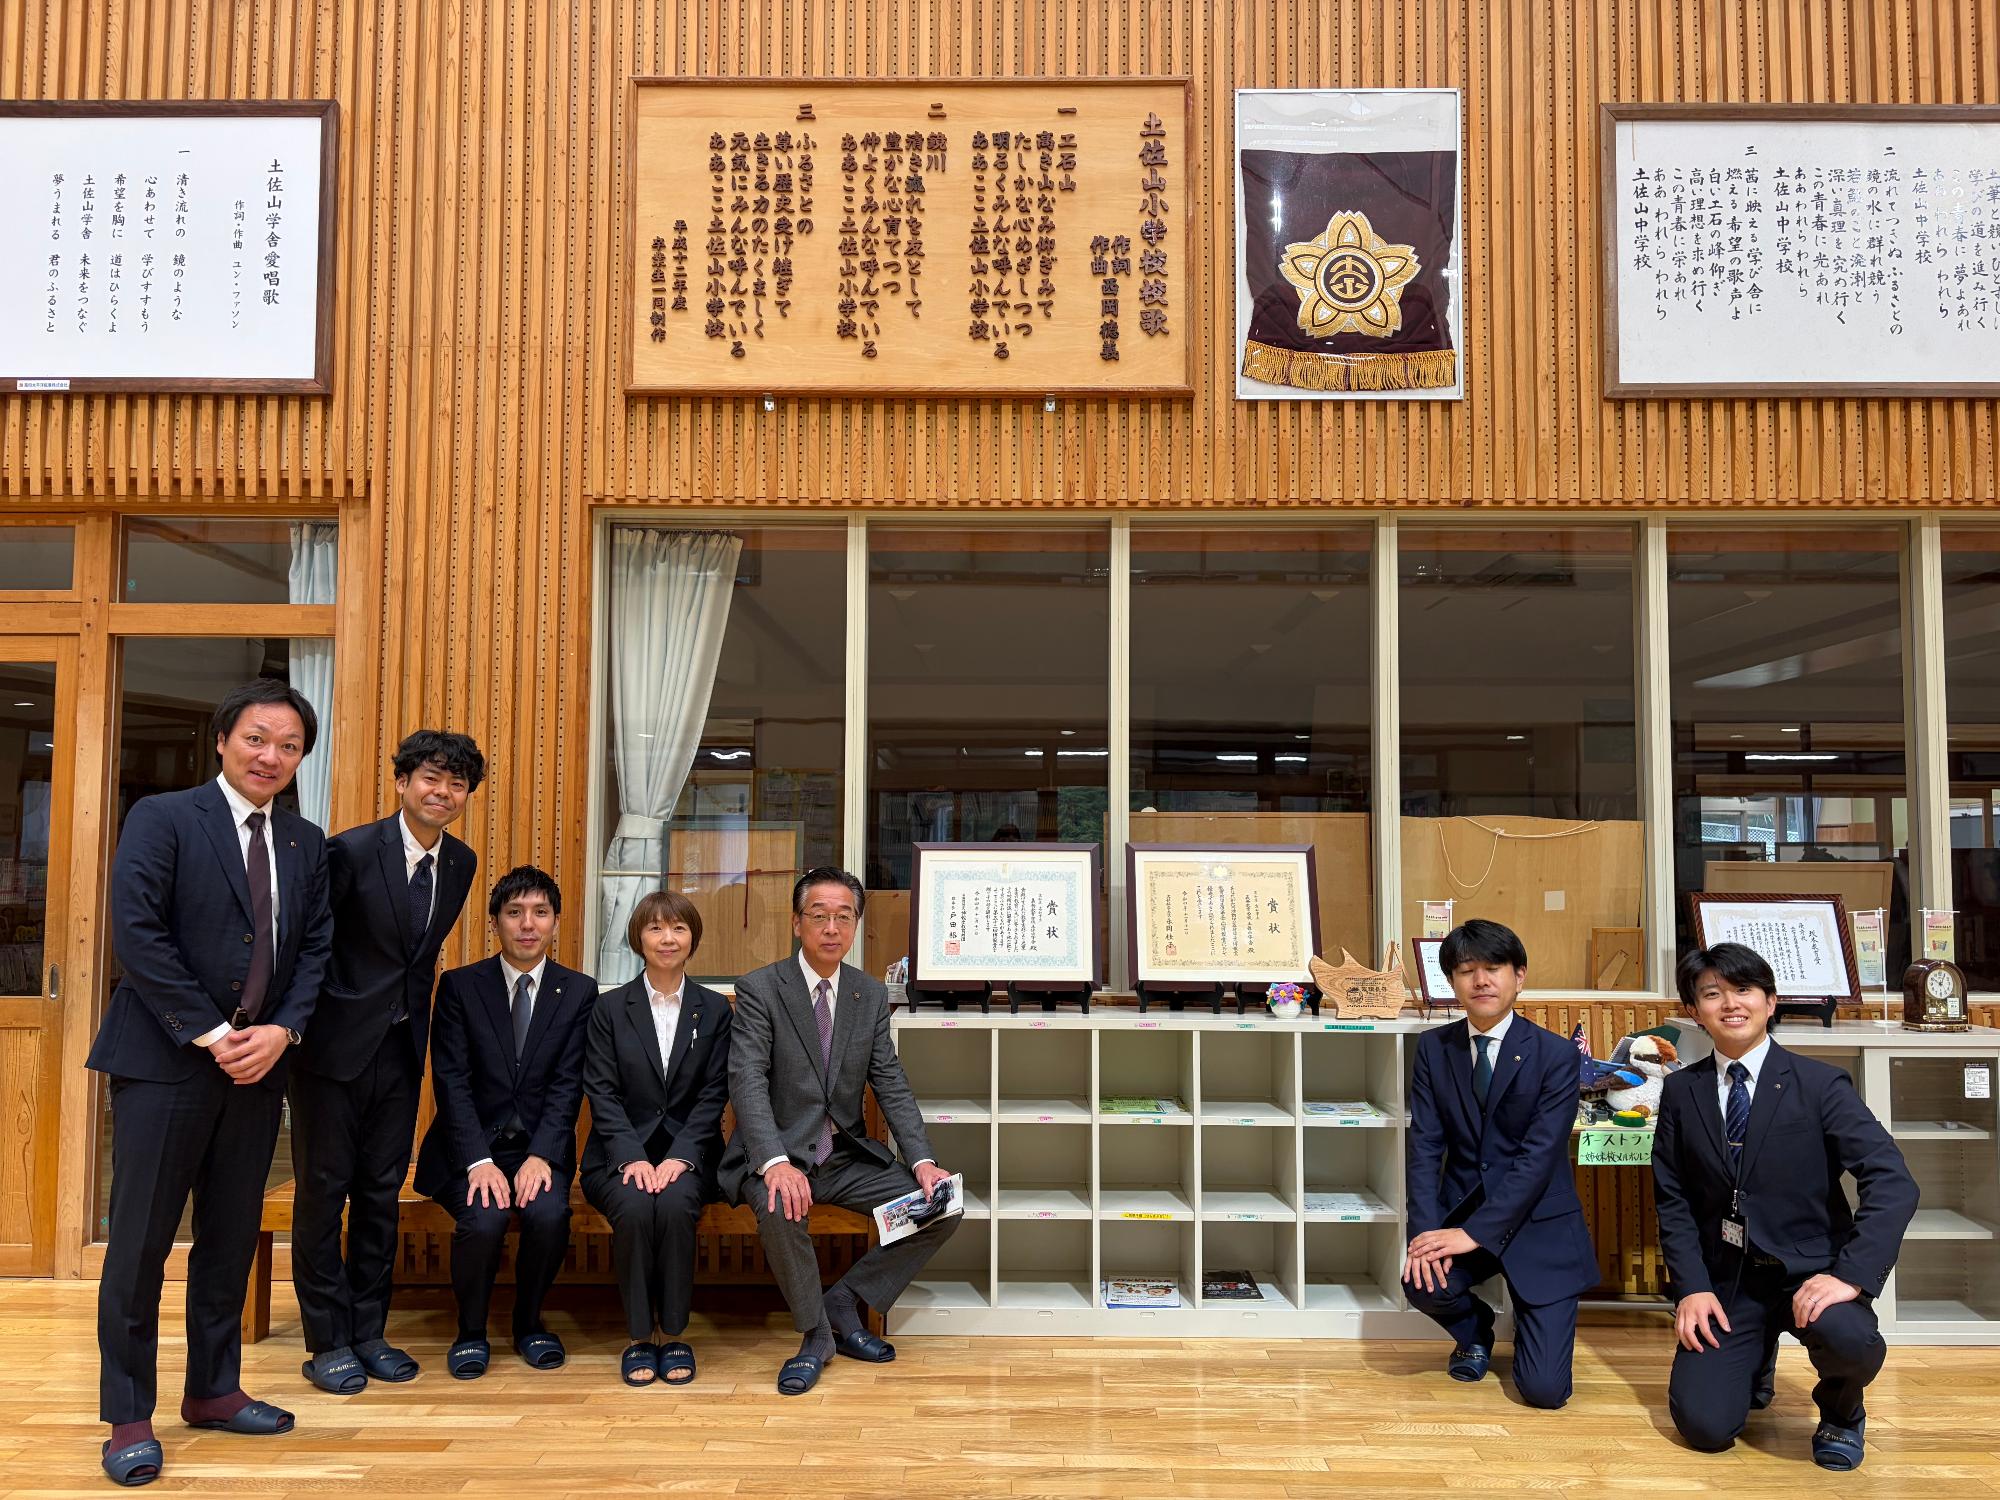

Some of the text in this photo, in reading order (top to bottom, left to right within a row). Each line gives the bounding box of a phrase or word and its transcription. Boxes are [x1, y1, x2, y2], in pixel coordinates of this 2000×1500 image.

[176, 173, 189, 237] 清き流れの
[796, 104, 816, 235] 三 ふるさとの
[926, 103, 947, 173] 二 鏡川
[1056, 134, 1077, 192] 工石山
[47, 174, 64, 332] 夢うまれる 君のふるさと
[78, 175, 95, 332] 土佐山学舎 未来をつなぐ
[109, 174, 126, 332] 希望を胸に 道はひらくよ
[140, 177, 157, 331] 心あわせて 学びすすもう
[172, 254, 185, 320] 鏡のような
[263, 159, 283, 305] 土佐山学舎愛唱歌
[672, 220, 687, 312] 平成十二年度
[705, 132, 726, 339] ああここ土佐山小学校
[728, 132, 751, 359] 元気にみんな呼んでいる
[752, 132, 771, 339] 生きる力のたくましく
[772, 131, 793, 318] 尊い歴史受け継ぎて
[837, 133, 858, 340] ああここ土佐山小学校
[860, 132, 880, 359] 仲よくみんな呼んでいる
[883, 132, 903, 295] 豊かな心育てつつ
[904, 131, 925, 319] 清き流れを友として
[970, 131, 990, 341] ああここ土佐山小学校
[992, 131, 1012, 360] 明るくみんな呼んでいる
[1013, 132, 1034, 336] たしかな心めざしつつ
[1036, 131, 1056, 319] 高き山なみ仰ぎみて
[1090, 235, 1109, 276] 作曲
[1111, 235, 1131, 276] 作詞
[1139, 112, 1169, 337] 土佐山小学校校歌
[1632, 168, 1652, 270] 土佐山中学校
[1670, 168, 1688, 301] この青春に栄あれ
[1689, 168, 1707, 312] 高い理想を求め行く
[1707, 168, 1726, 296] 白い工石の峰仰ぎ
[1724, 168, 1744, 320] 燃える希望の歌声よ
[1744, 145, 1763, 314] 三 茜に映える学び舎に
[1772, 167, 1794, 273] 土佐山中学校
[1810, 168, 1830, 305] この青春に光あれ
[1827, 168, 1849, 325] 深い真理を究め行く
[1864, 168, 1886, 304] 鏡の水に群れ競う
[1912, 168, 1933, 264] 土佐山中学校
[1969, 169, 1989, 328] 学びの道を進み行く
[650, 236, 666, 343] 卒業生一同制作
[1046, 900, 1059, 939] 賞状
[1267, 897, 1280, 934] 賞状
[1582, 1132, 1651, 1147] オーストラ
